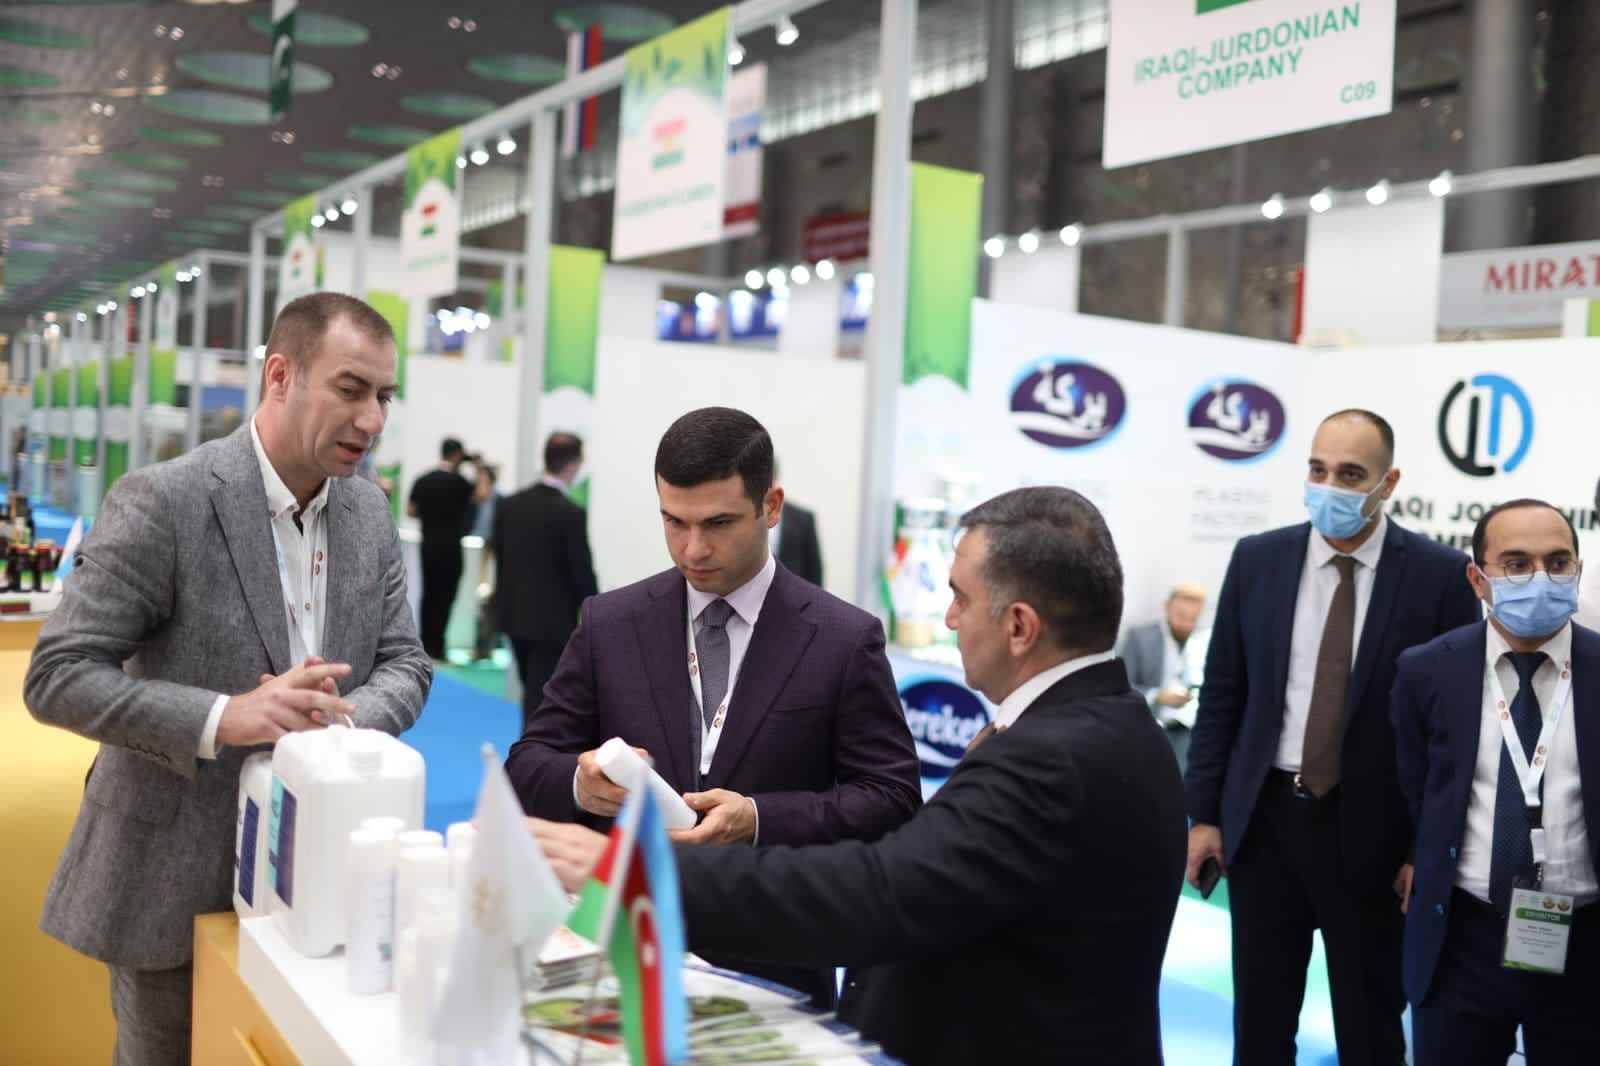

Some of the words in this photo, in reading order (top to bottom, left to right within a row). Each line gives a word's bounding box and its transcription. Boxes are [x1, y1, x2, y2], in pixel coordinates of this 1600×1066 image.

[1133, 2, 1360, 83] IRAQI-JURDONIAN
[1178, 48, 1303, 99] COMPANY
[1340, 80, 1376, 104] C09
[1391, 497, 1433, 520] AQI
[903, 703, 986, 748] ereket
